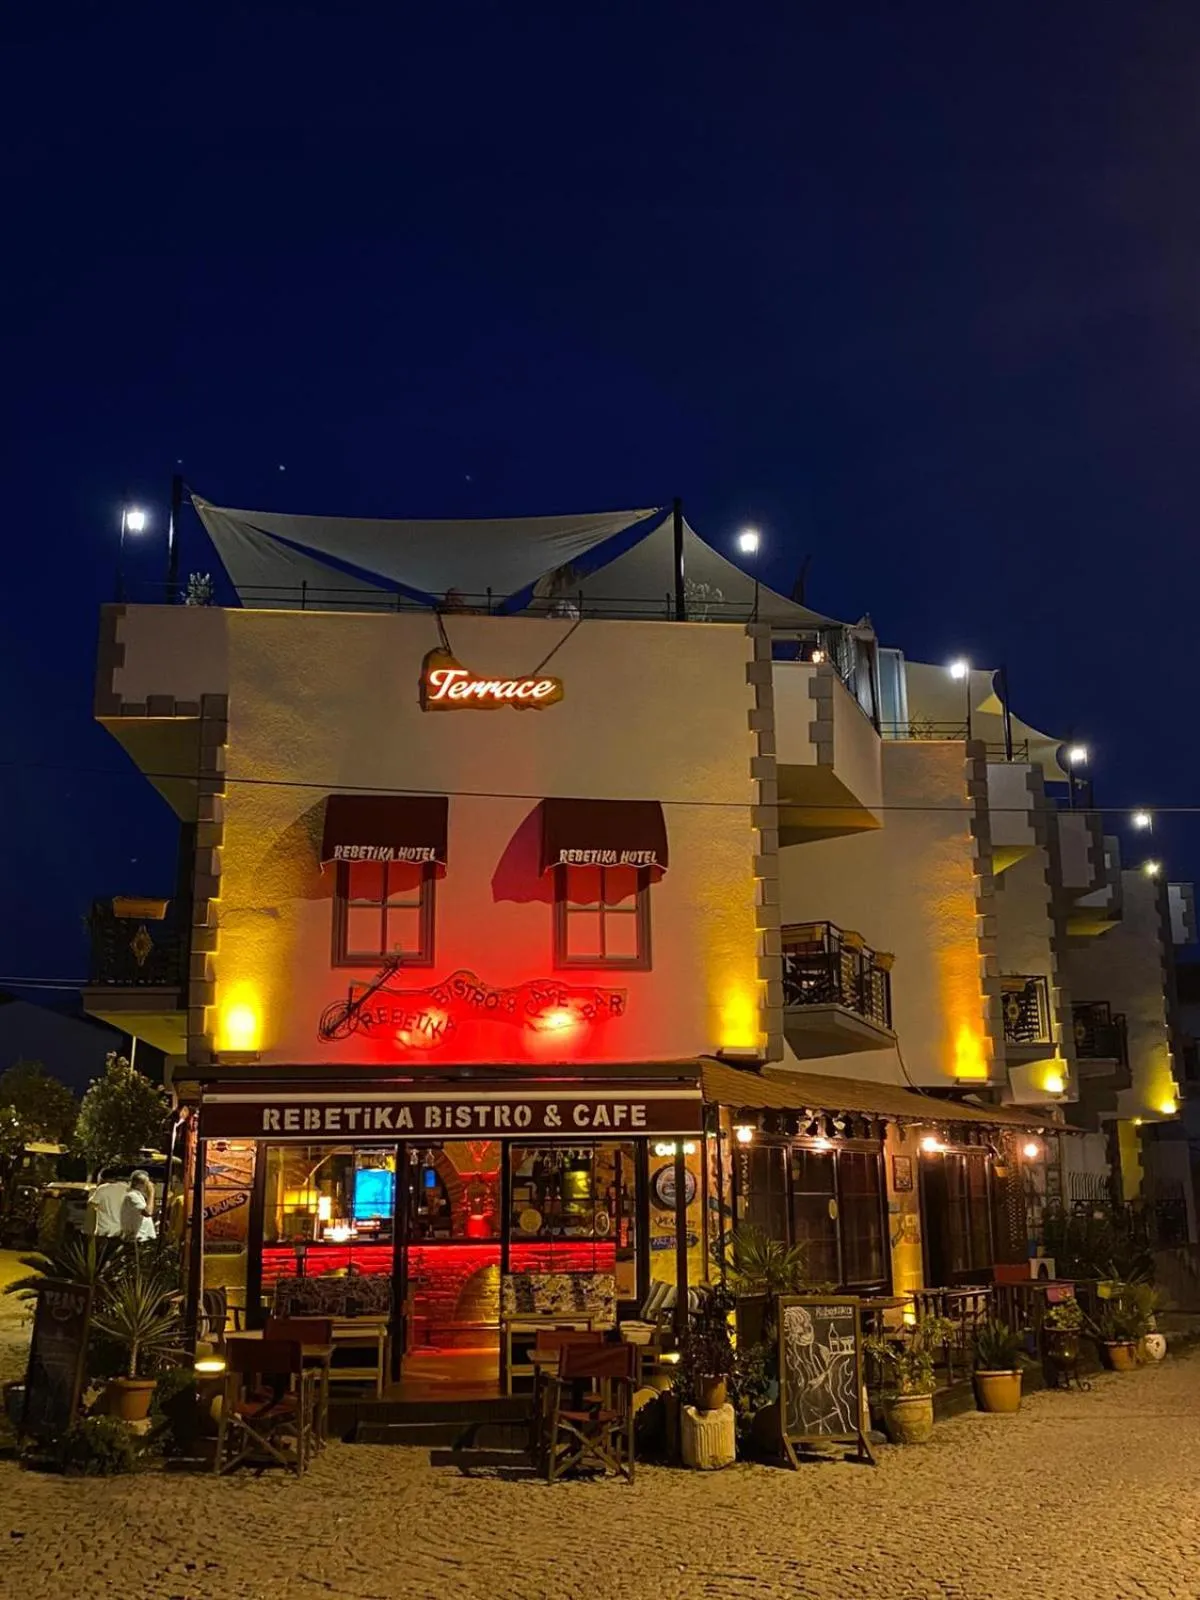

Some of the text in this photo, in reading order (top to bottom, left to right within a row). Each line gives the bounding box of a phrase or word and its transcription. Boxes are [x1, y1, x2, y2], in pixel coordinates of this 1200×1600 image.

[428, 669, 556, 700] Terrace
[398, 847, 436, 861] HOTEL
[620, 850, 658, 863] HOTEL
[359, 1006, 458, 1040] REBETIKA
[431, 978, 500, 1009] BISTRO
[524, 986, 569, 1019] CAFE
[582, 989, 623, 1020] BAR
[543, 1104, 563, 1127] &
[573, 1104, 647, 1127] CAFE
